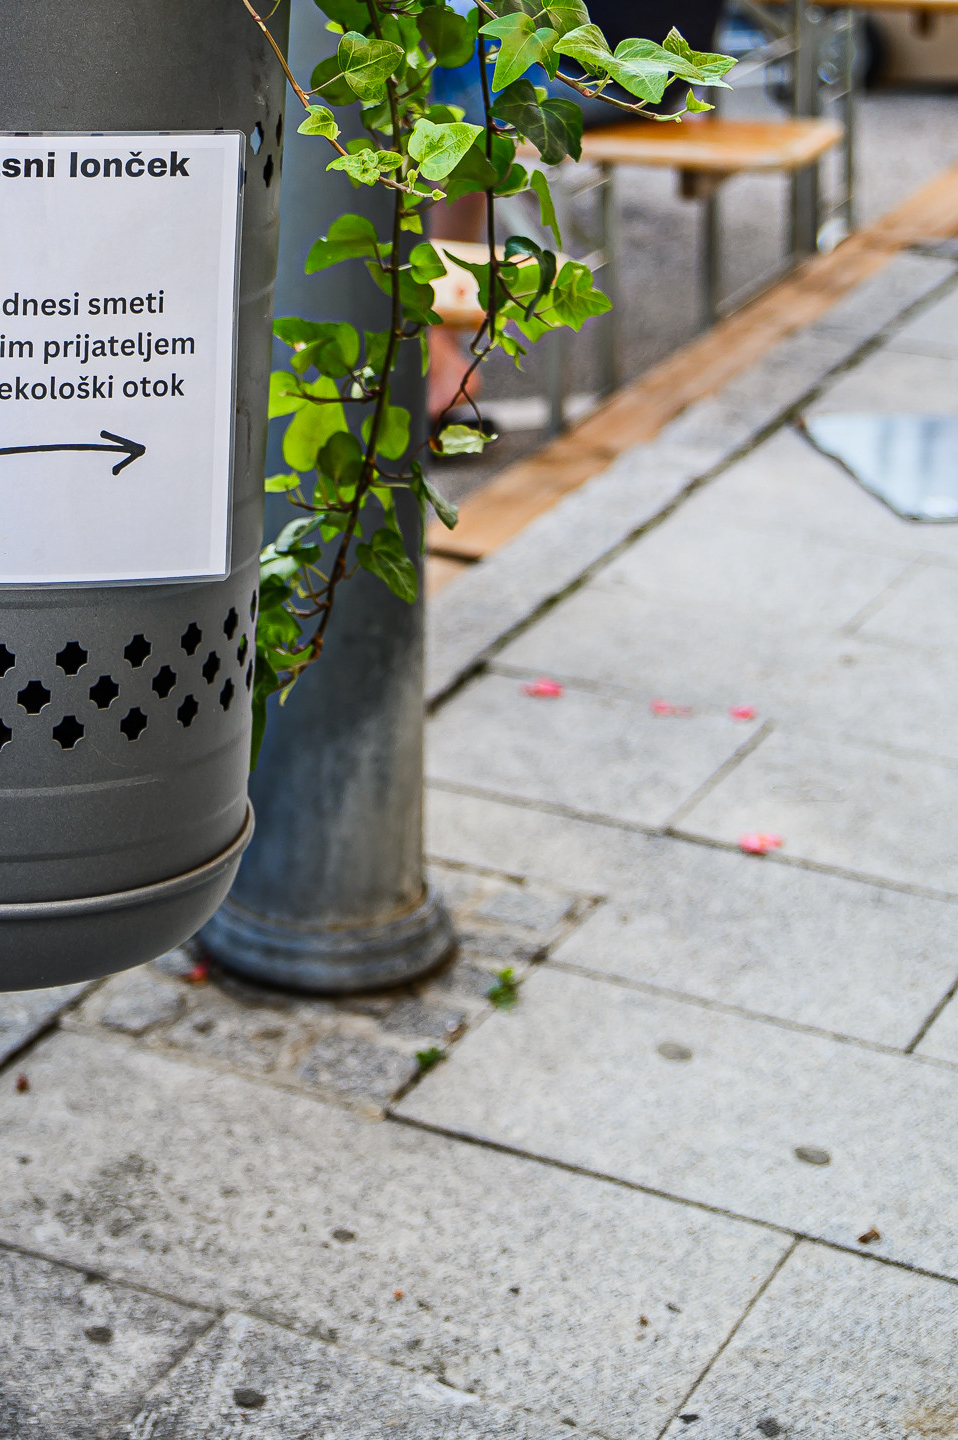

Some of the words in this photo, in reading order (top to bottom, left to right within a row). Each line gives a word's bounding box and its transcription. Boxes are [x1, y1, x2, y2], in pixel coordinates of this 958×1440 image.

[69, 150, 191, 178] lonček
[87, 289, 165, 316] smeti
[43, 331, 195, 365] prijateljem
[122, 372, 185, 398] otok
